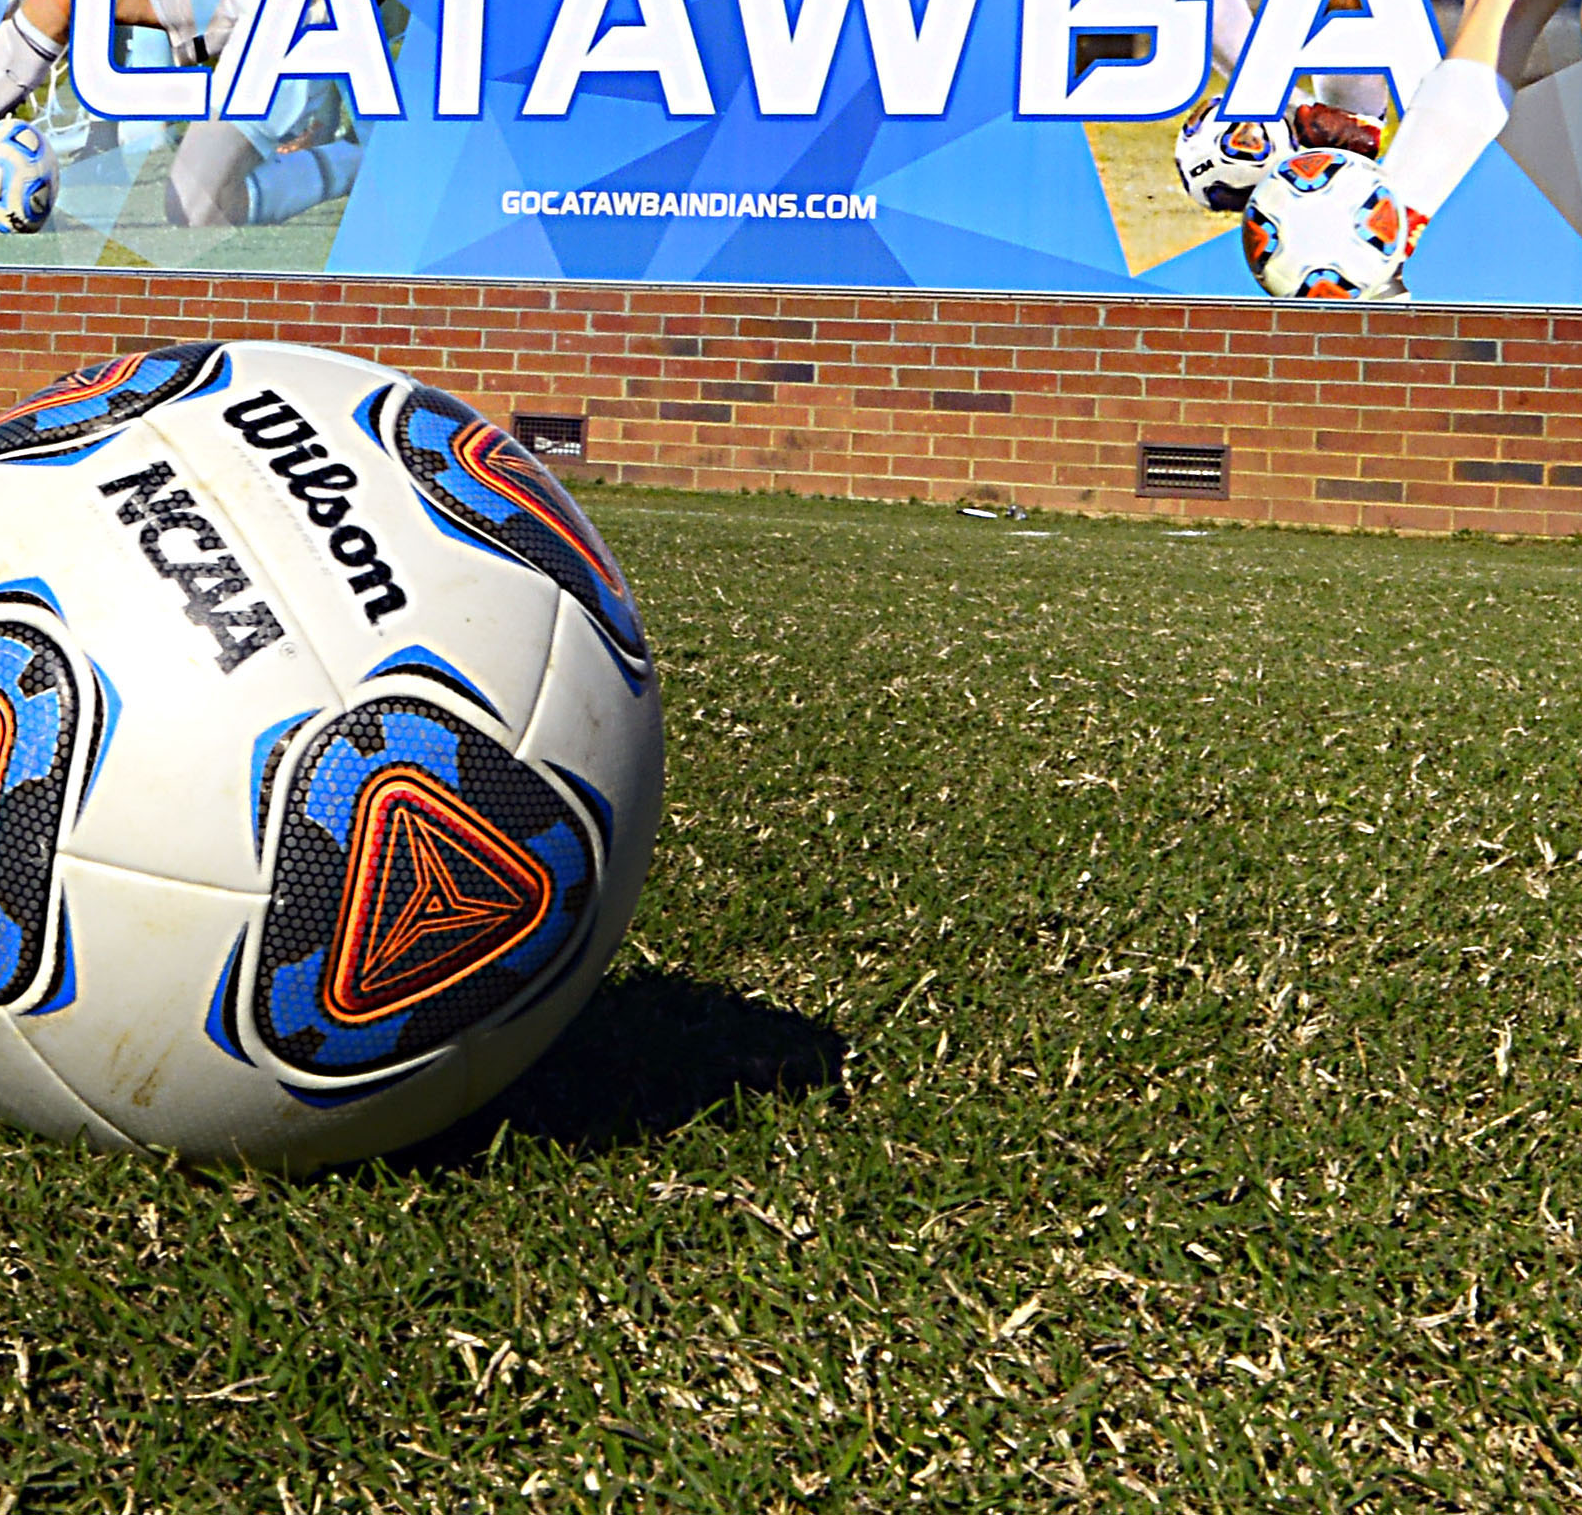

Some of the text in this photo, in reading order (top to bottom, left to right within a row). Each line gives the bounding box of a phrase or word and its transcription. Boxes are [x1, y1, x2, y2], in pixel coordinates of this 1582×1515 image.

[501, 189, 878, 220] GOCATAWBAINDIANS.COM
[96, 460, 286, 676] NCAA
[222, 388, 408, 627] Wilson
